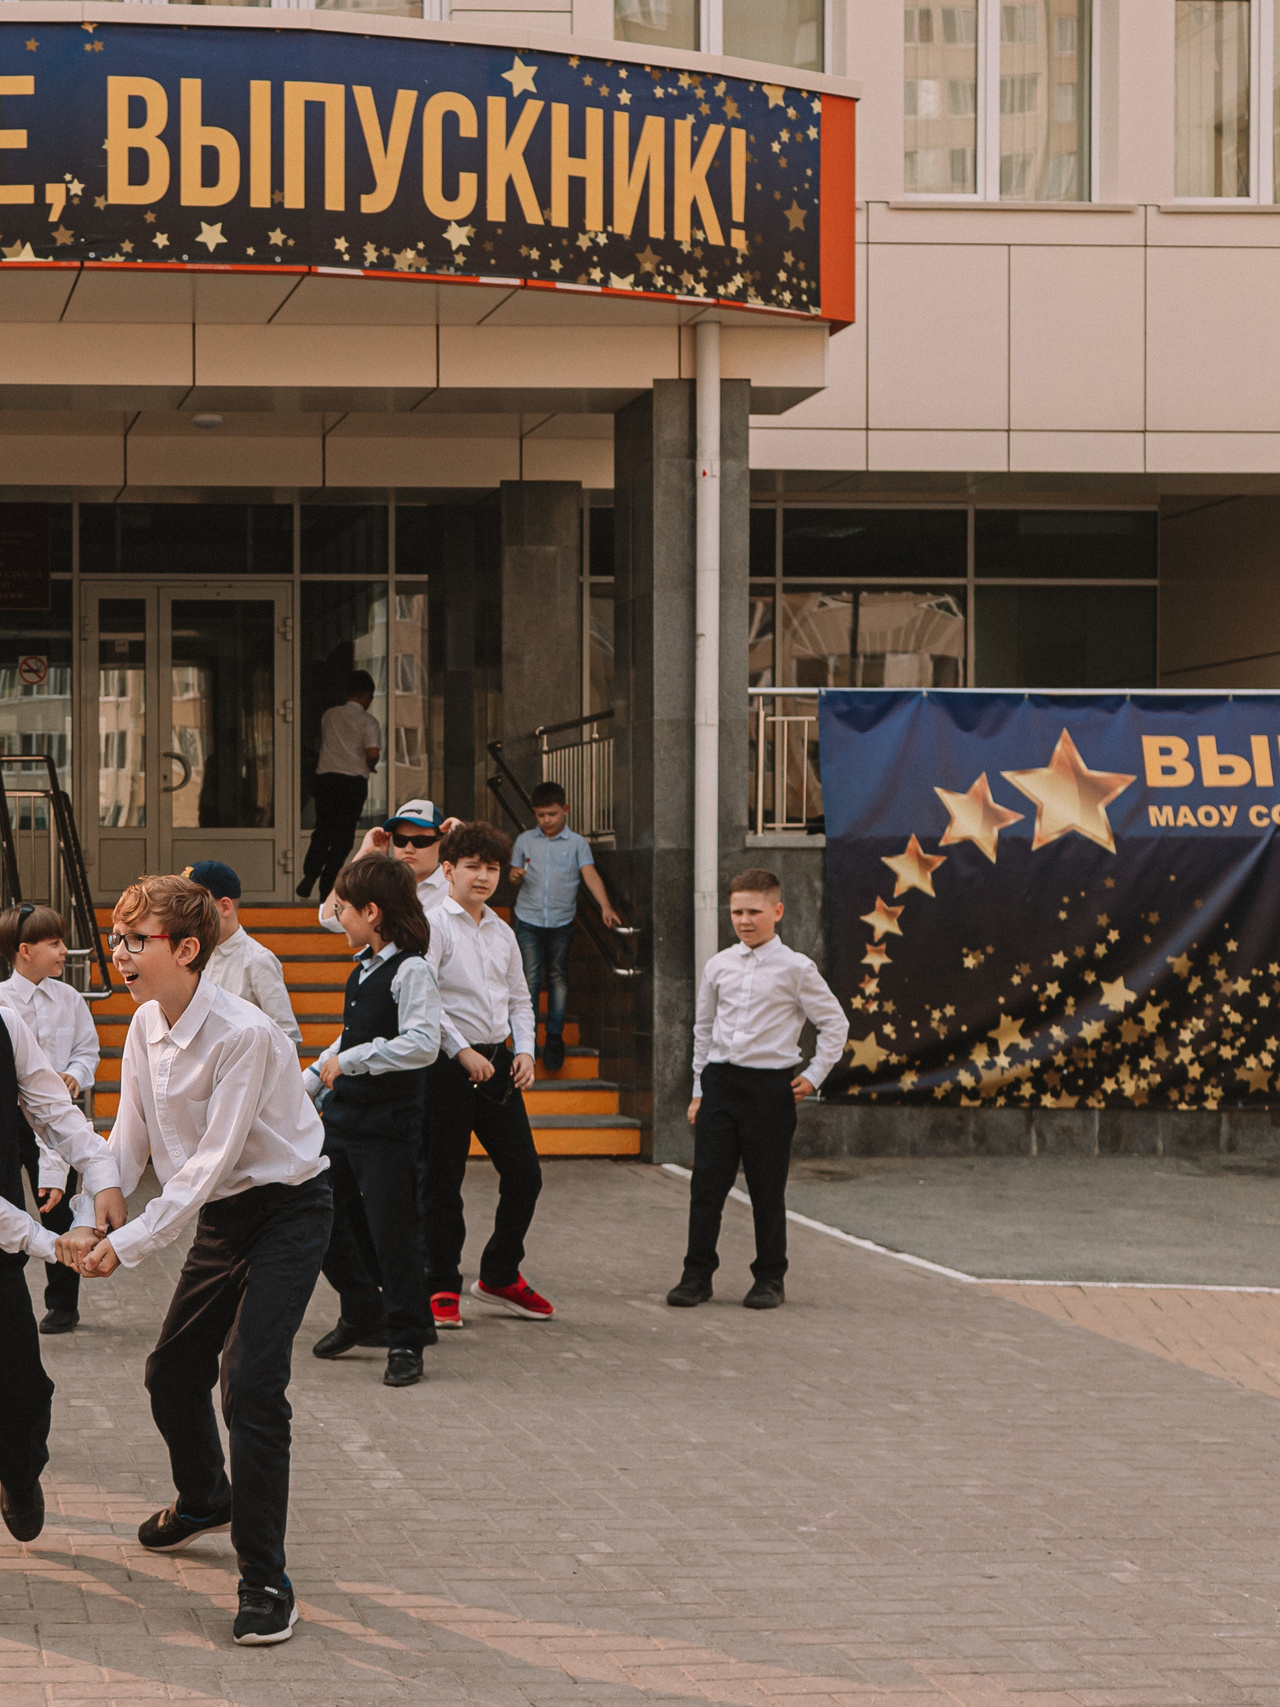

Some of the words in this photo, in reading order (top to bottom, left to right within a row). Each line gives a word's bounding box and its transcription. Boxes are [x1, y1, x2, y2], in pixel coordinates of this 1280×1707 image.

[106, 75, 747, 251] ВЫПУСКНИК!
[1141, 735, 1280, 788] ВЫ
[1148, 804, 1238, 828] МАОУ
